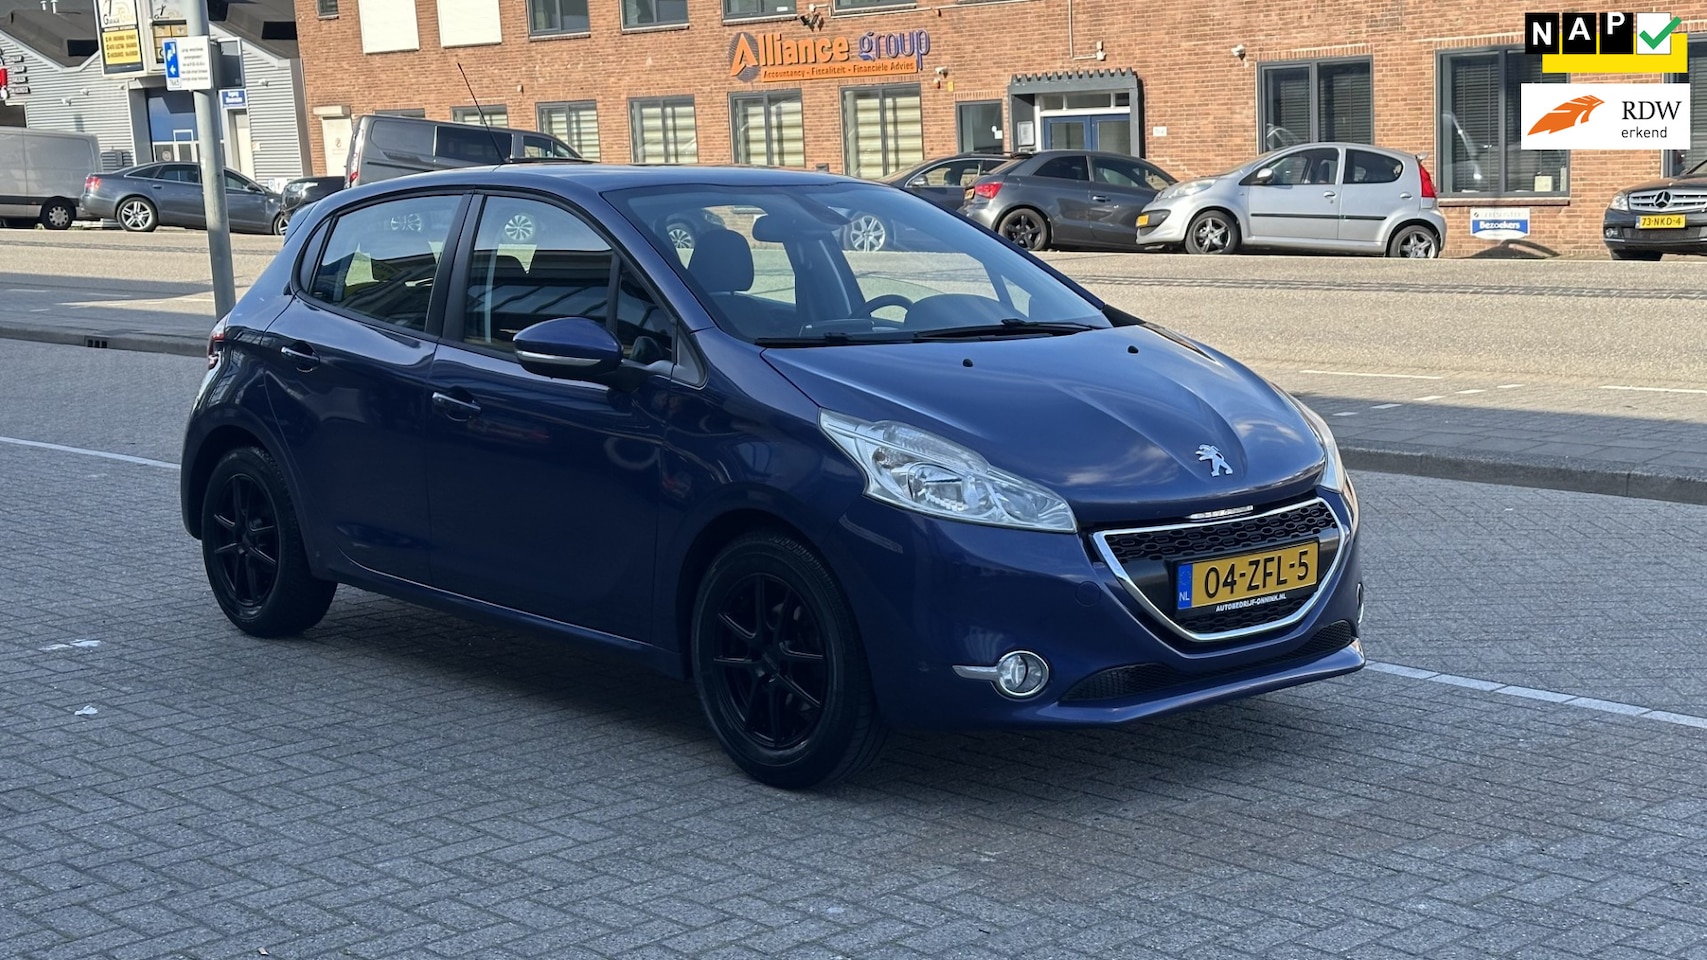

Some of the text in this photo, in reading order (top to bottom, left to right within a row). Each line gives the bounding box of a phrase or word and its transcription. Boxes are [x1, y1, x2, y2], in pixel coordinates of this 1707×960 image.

[730, 27, 931, 77] Alliance group
[763, 69, 806, 79] Accountancy
[811, 66, 846, 76] Fiscaliteit
[890, 61, 914, 71] Advies
[1479, 220, 1520, 230] Bezoekers
[1641, 217, 1681, 227] 73-NKD-4
[1204, 550, 1309, 599] 04-ZFL-5
[1179, 591, 1190, 601] NL
